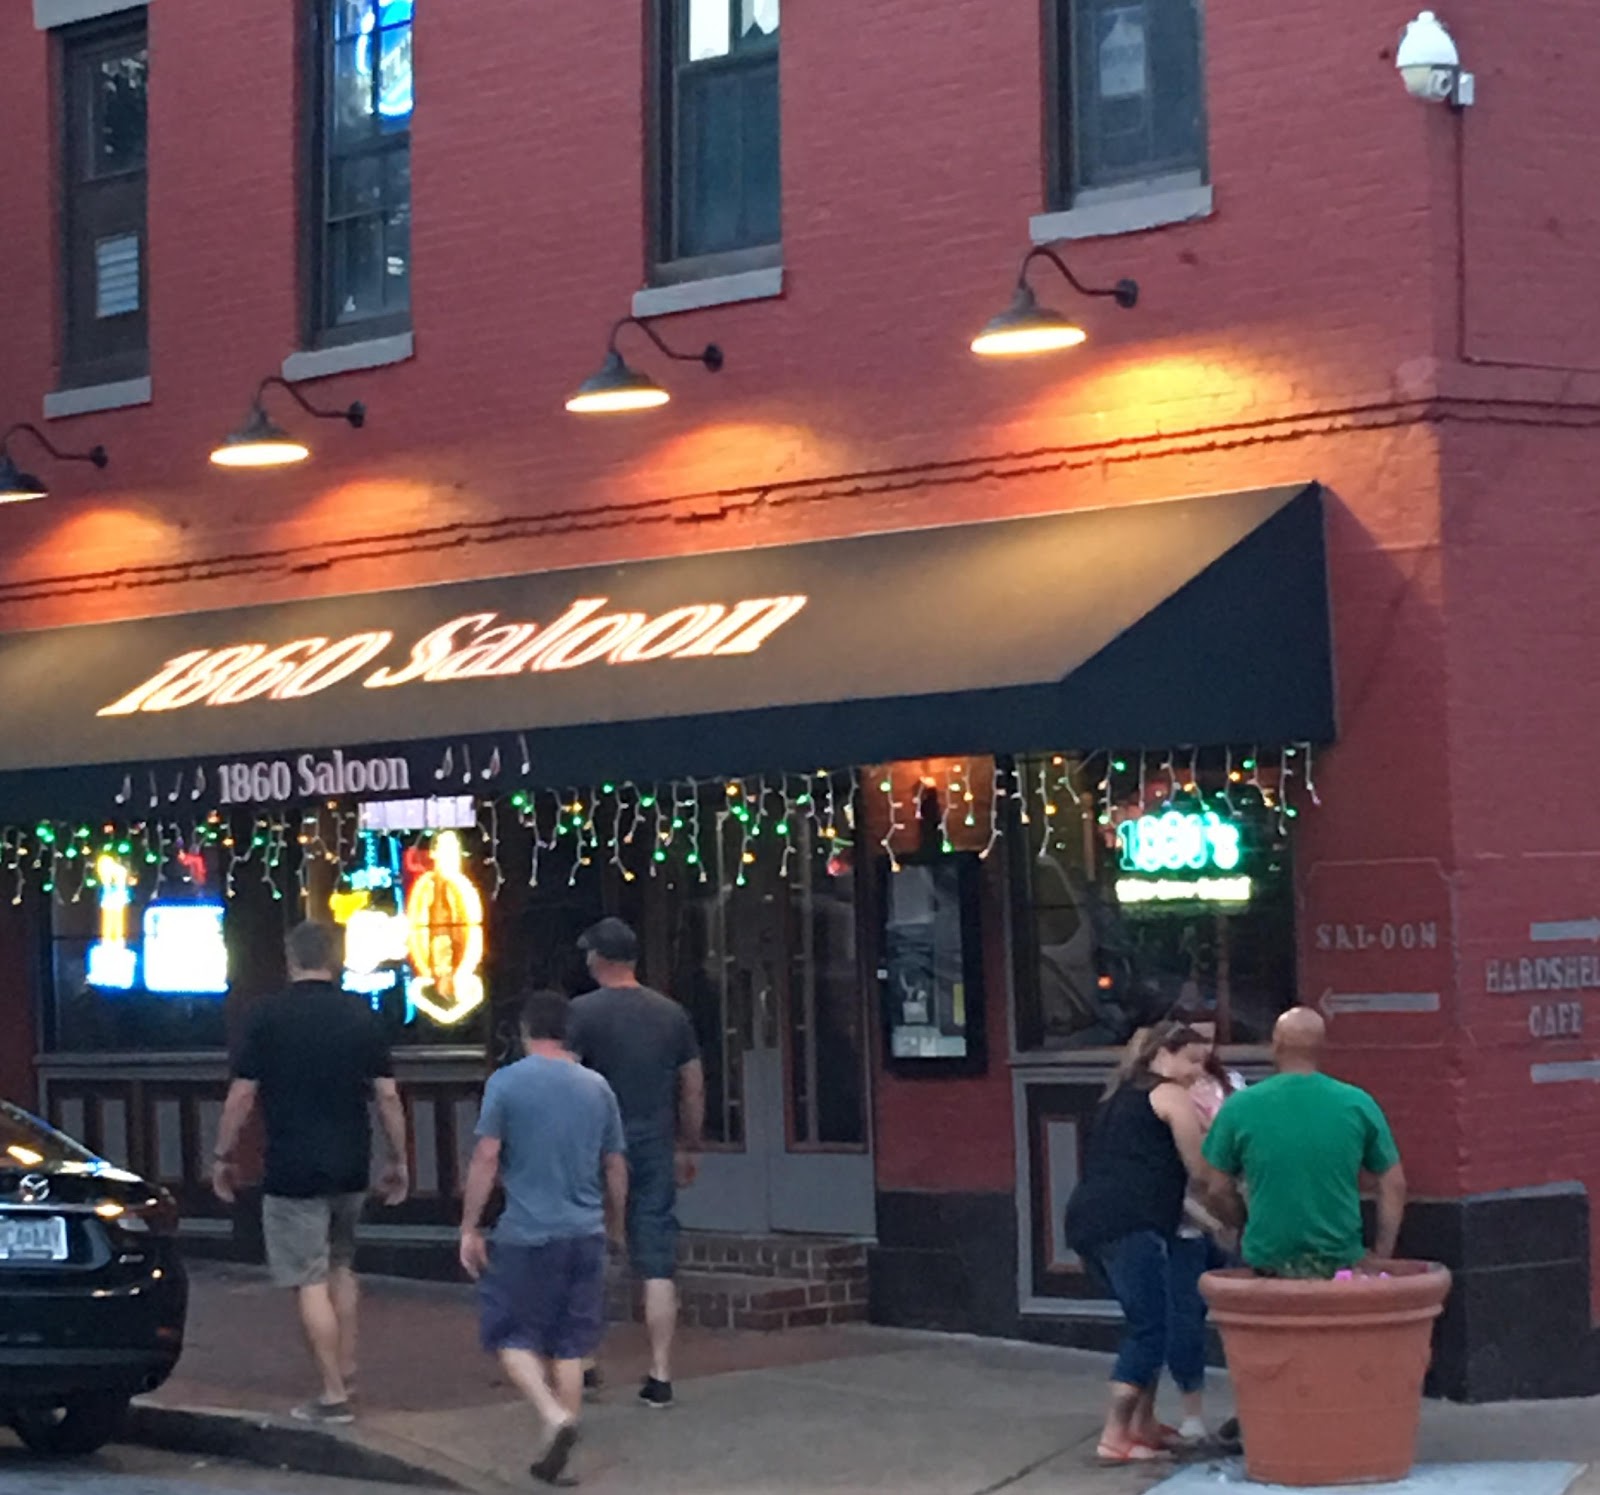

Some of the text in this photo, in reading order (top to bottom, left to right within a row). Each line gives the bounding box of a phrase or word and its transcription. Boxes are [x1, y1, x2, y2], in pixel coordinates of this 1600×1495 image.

[96, 595, 808, 717] 1860 Saloon
[218, 750, 411, 804] 1860 Saloon
[1315, 921, 1437, 951] SALOON
[1529, 1002, 1584, 1037] CAFE
